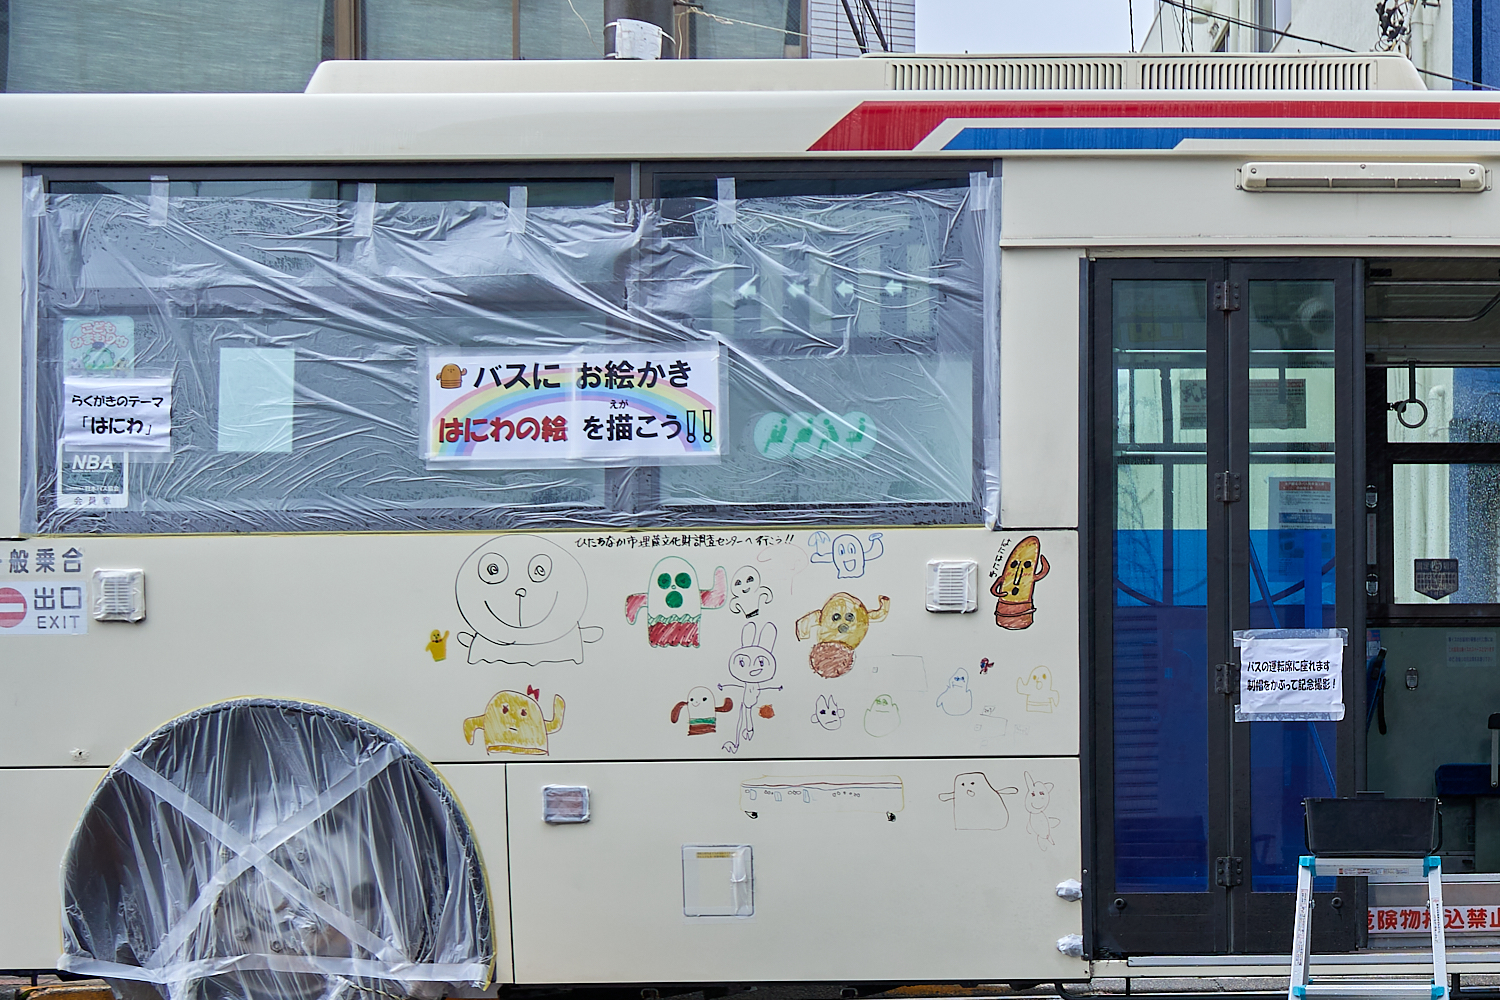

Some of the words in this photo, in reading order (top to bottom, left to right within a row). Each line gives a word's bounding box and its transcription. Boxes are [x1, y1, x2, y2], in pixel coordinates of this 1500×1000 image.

[473, 363, 561, 389] バスに
[576, 360, 691, 389] お絵かき
[72, 395, 164, 407] らくがきのテーマ
[609, 399, 629, 409] えが
[82, 416, 152, 435] 「はにわ」
[439, 415, 568, 443] はにわの絵
[71, 454, 114, 470] NBA
[0, 547, 83, 573] 般乗合
[34, 587, 82, 610] 出口
[37, 616, 80, 629] EXIT
[1247, 660, 1331, 672] バスの運転席に座れます
